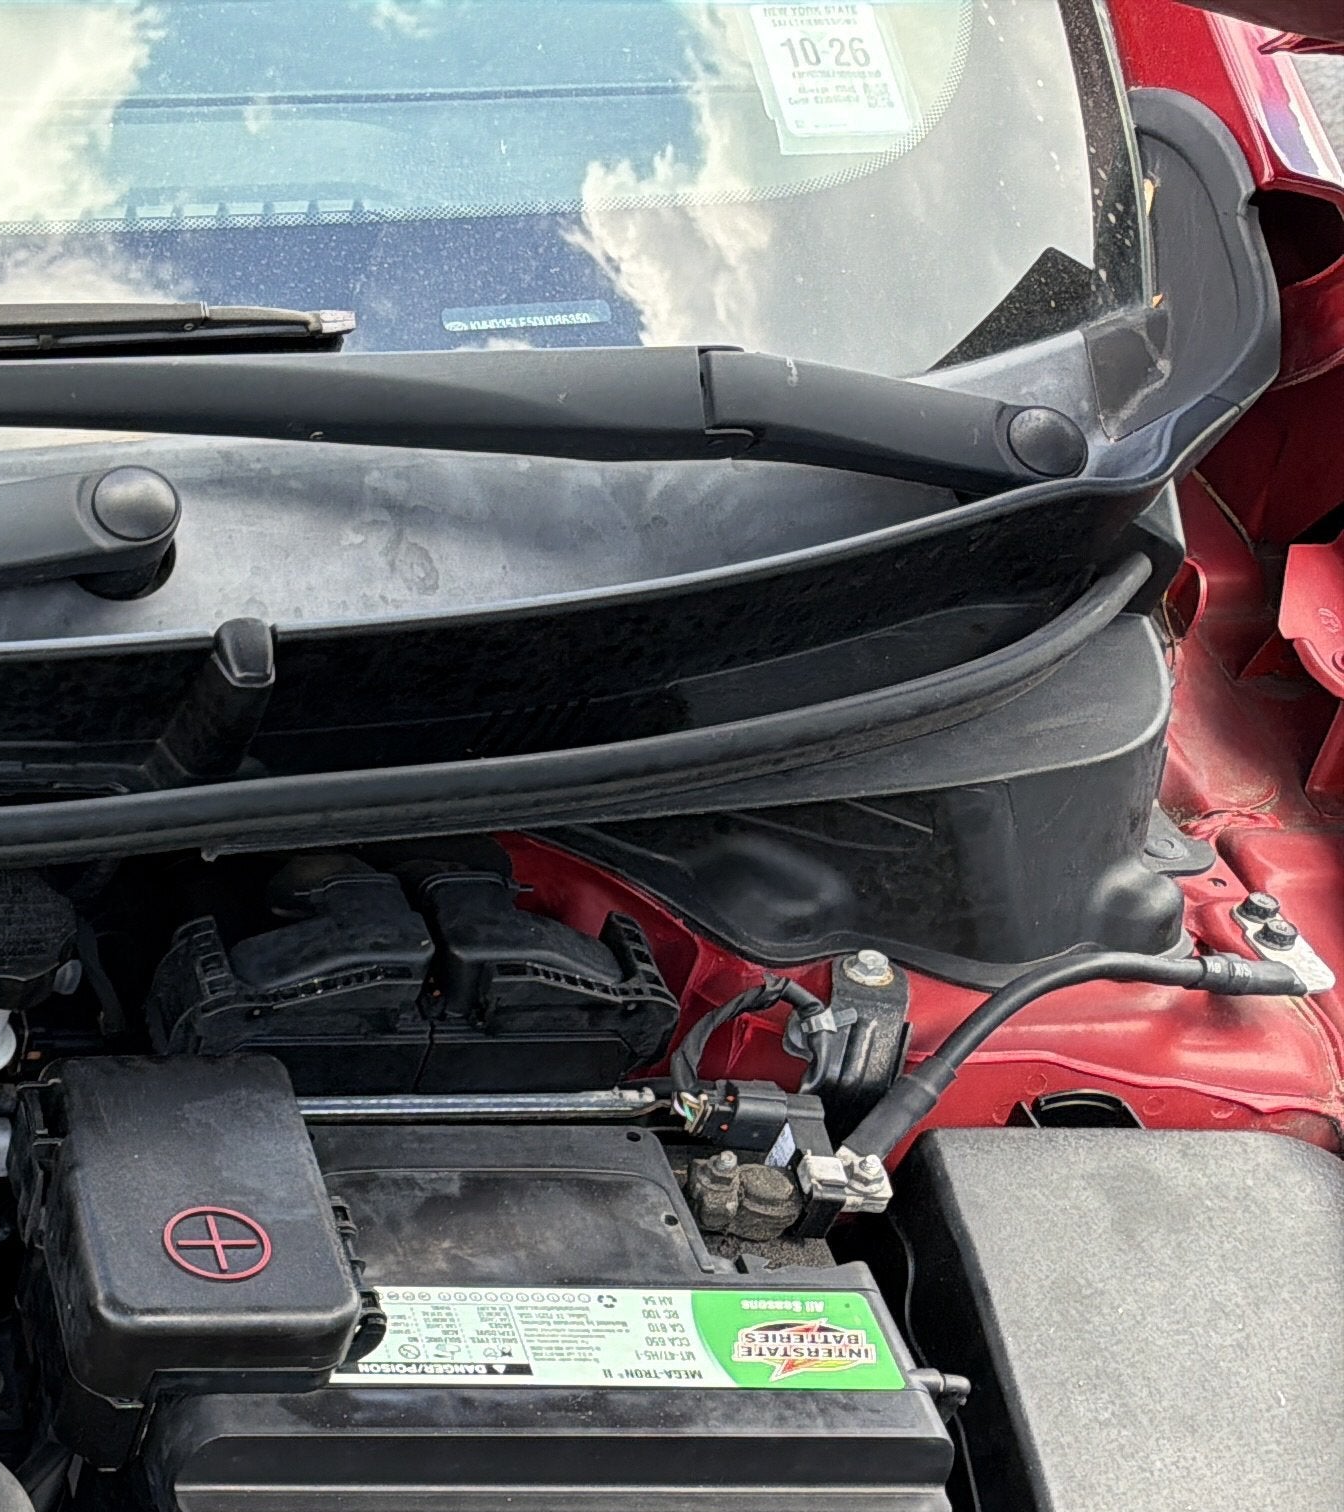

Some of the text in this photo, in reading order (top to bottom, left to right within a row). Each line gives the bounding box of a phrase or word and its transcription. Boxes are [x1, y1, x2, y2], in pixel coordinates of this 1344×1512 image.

[764, 5, 858, 17] NEW YORK STATE
[780, 37, 870, 67] 10-26
[643, 1296, 674, 1306] AH 54
[740, 1299, 825, 1313] All Seasons
[642, 1309, 680, 1319] RC 100
[648, 1322, 685, 1333] CA 810
[646, 1337, 690, 1347] CCA 650
[744, 1333, 860, 1345] BATTERIES
[741, 1346, 870, 1359] INTERSTATE
[358, 1363, 488, 1374] DANGER/POISON
